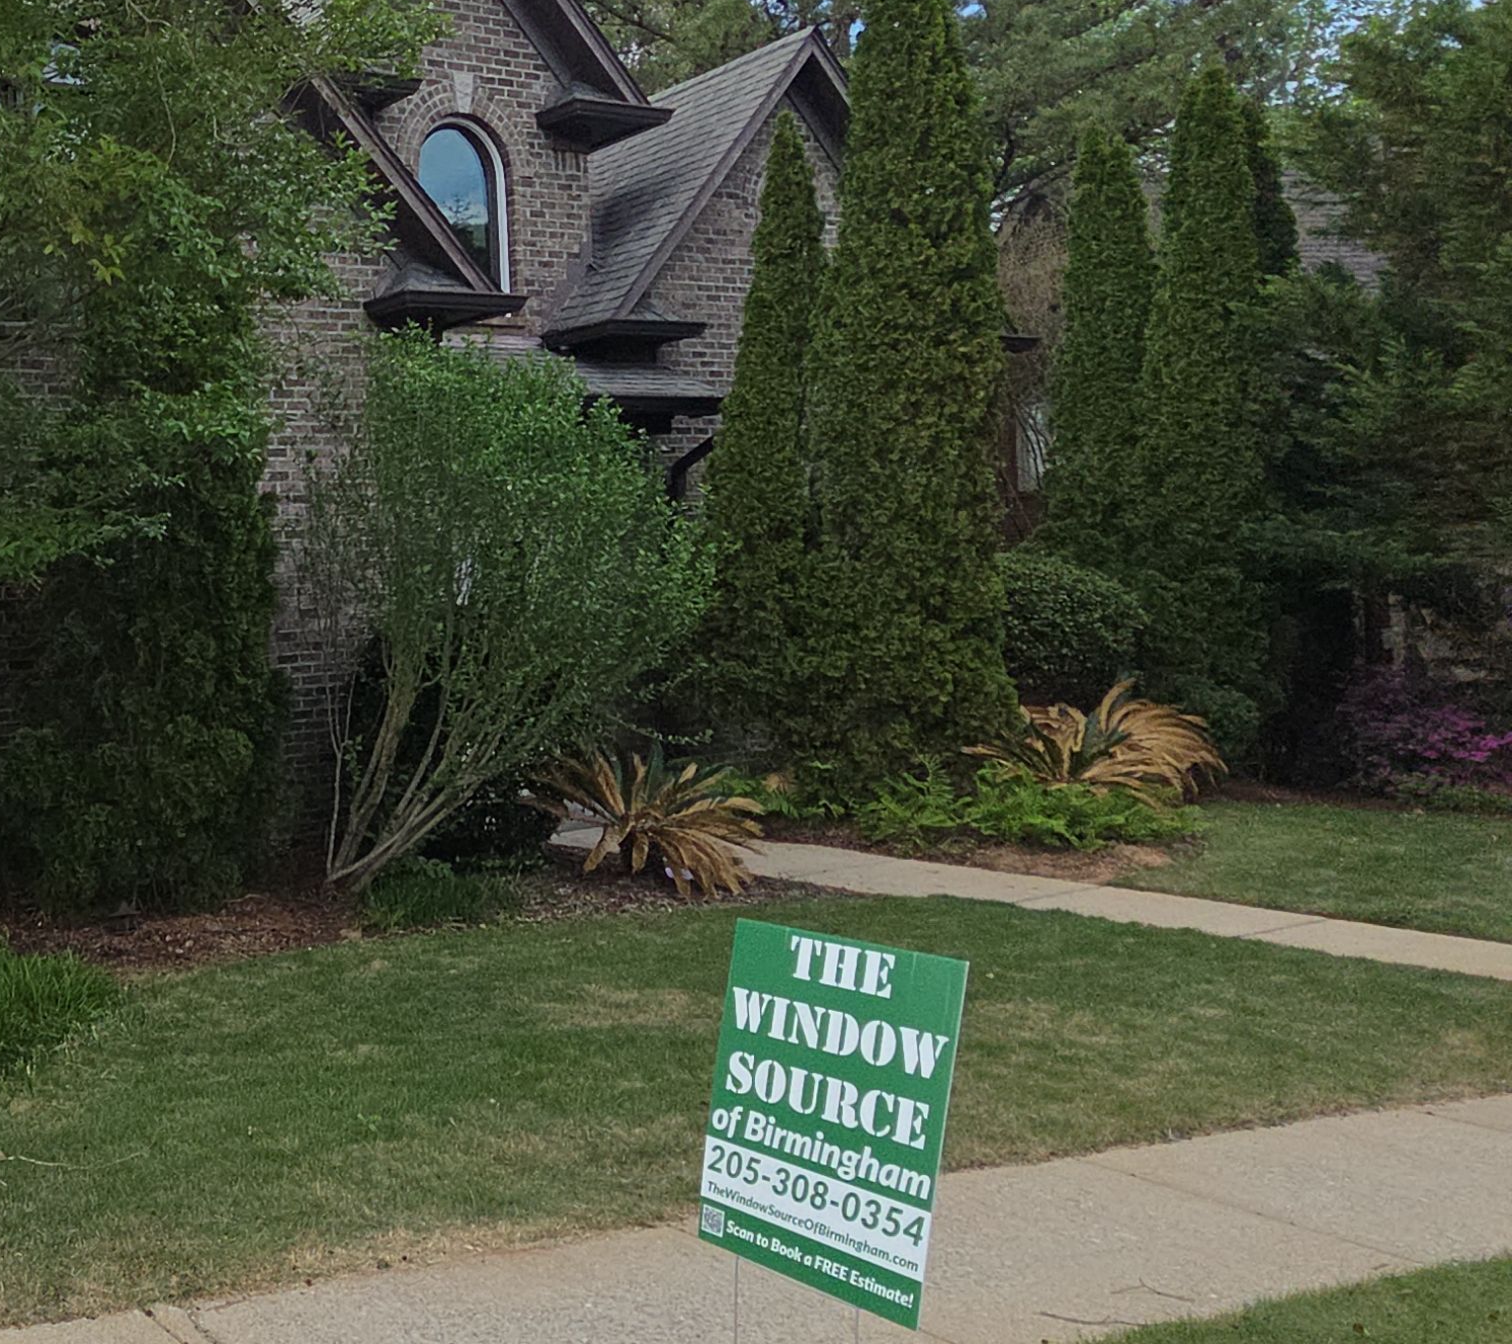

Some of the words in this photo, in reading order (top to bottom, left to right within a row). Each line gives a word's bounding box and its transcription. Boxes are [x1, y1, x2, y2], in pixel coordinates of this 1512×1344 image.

[790, 935, 895, 999] THE
[733, 986, 949, 1079] WINDOW
[725, 1051, 930, 1150] SOURCE
[707, 1144, 926, 1247] 205-308-0354
[711, 1106, 743, 1138] of
[743, 1109, 932, 1200] Birmingham
[707, 1181, 919, 1273] TheWindowSourceOfBirmingham.com
[726, 1219, 754, 1243] Scan
[755, 1233, 769, 1248] to
[770, 1237, 803, 1263] Book
[803, 1255, 812, 1267] a
[813, 1255, 849, 1282] FREE
[849, 1269, 915, 1309] Estimate!
